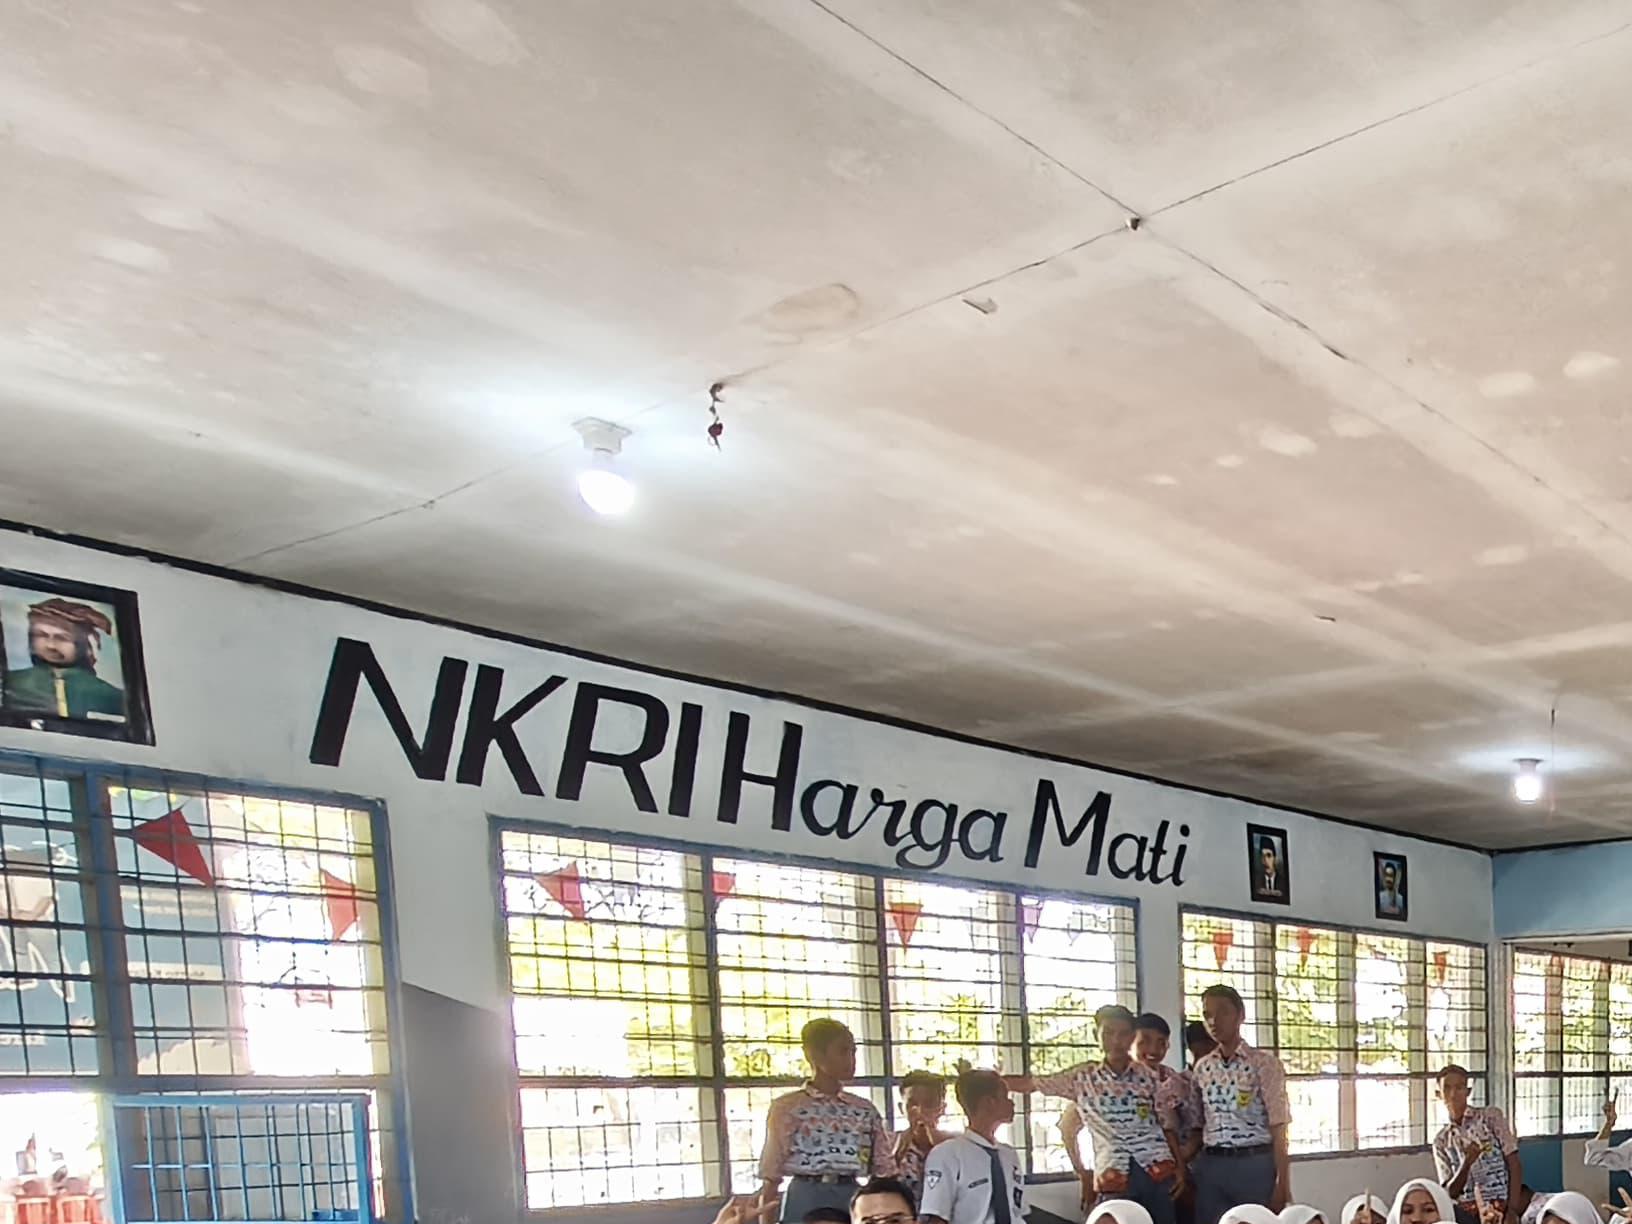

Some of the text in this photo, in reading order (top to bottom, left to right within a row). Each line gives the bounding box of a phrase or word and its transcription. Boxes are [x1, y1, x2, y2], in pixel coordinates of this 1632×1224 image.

[309, 635, 1190, 887] NKRI Harga Mati
